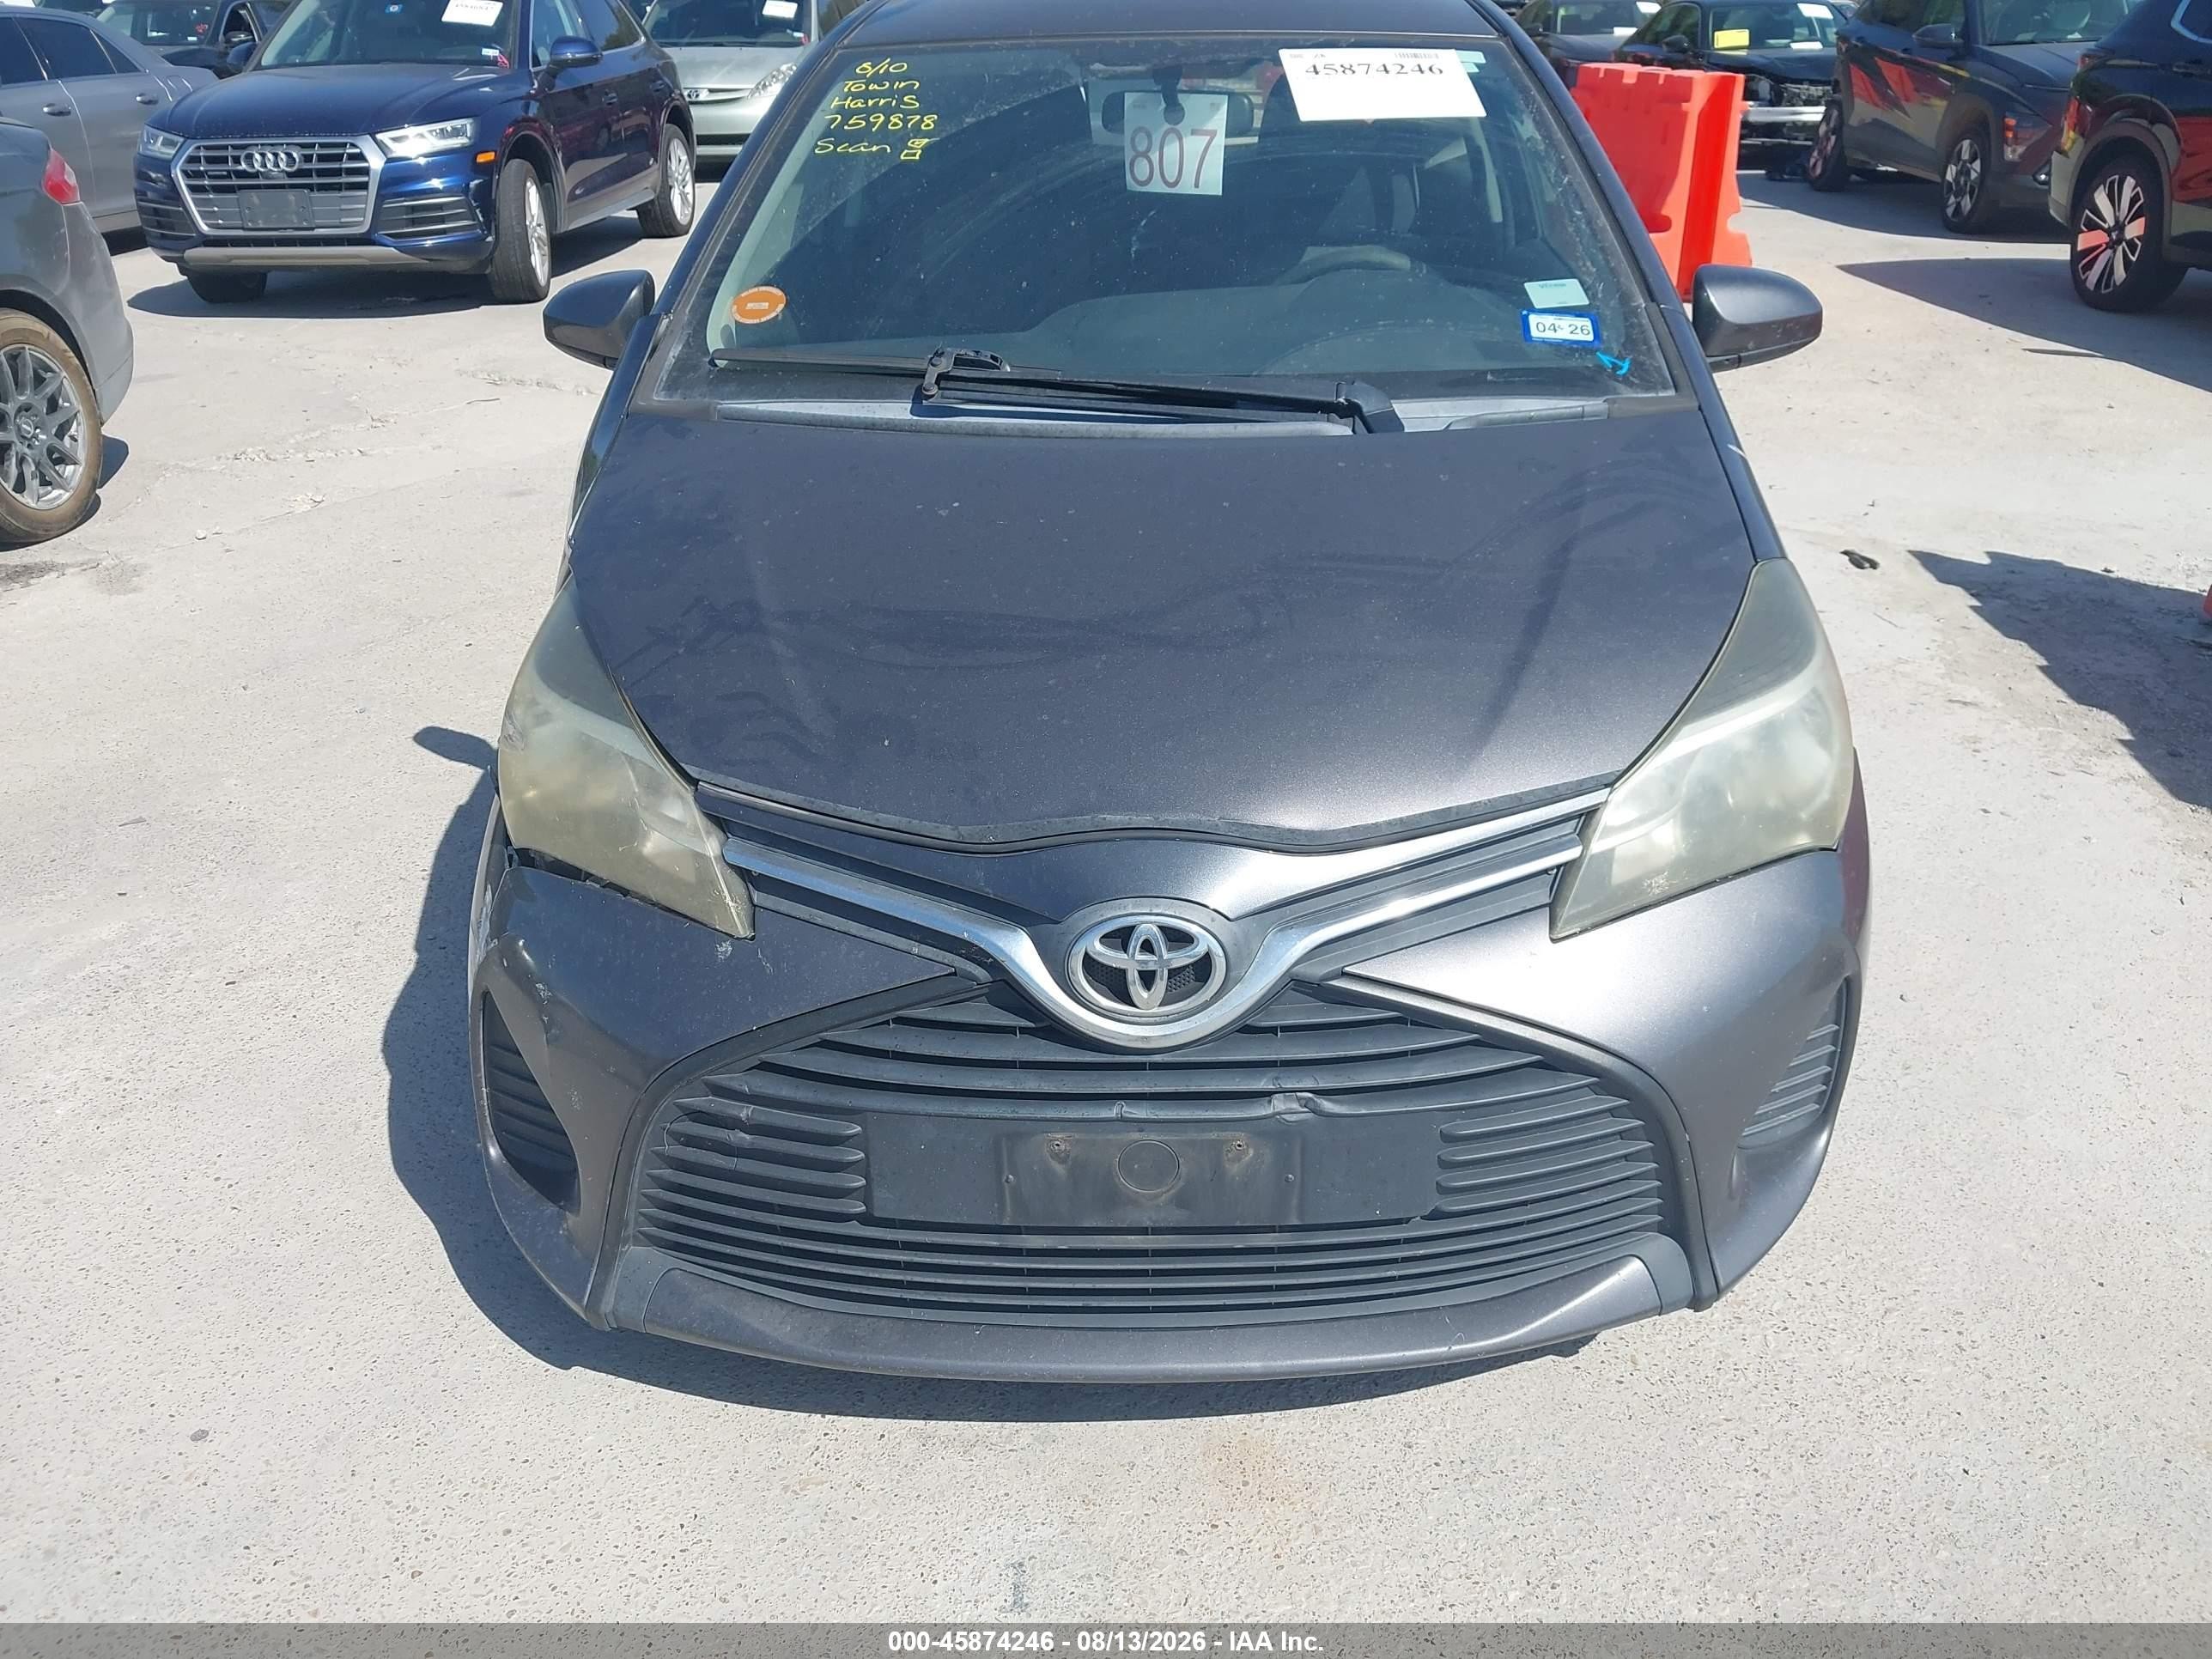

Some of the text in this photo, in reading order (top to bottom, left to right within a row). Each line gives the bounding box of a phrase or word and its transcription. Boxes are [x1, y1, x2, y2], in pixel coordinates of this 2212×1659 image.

[1304, 63, 1443, 76] 45874246
[824, 113, 938, 132] 759878
[814, 137, 891, 153] Scan
[1129, 126, 1218, 189] 807
[1535, 321, 1590, 336] 04 26
